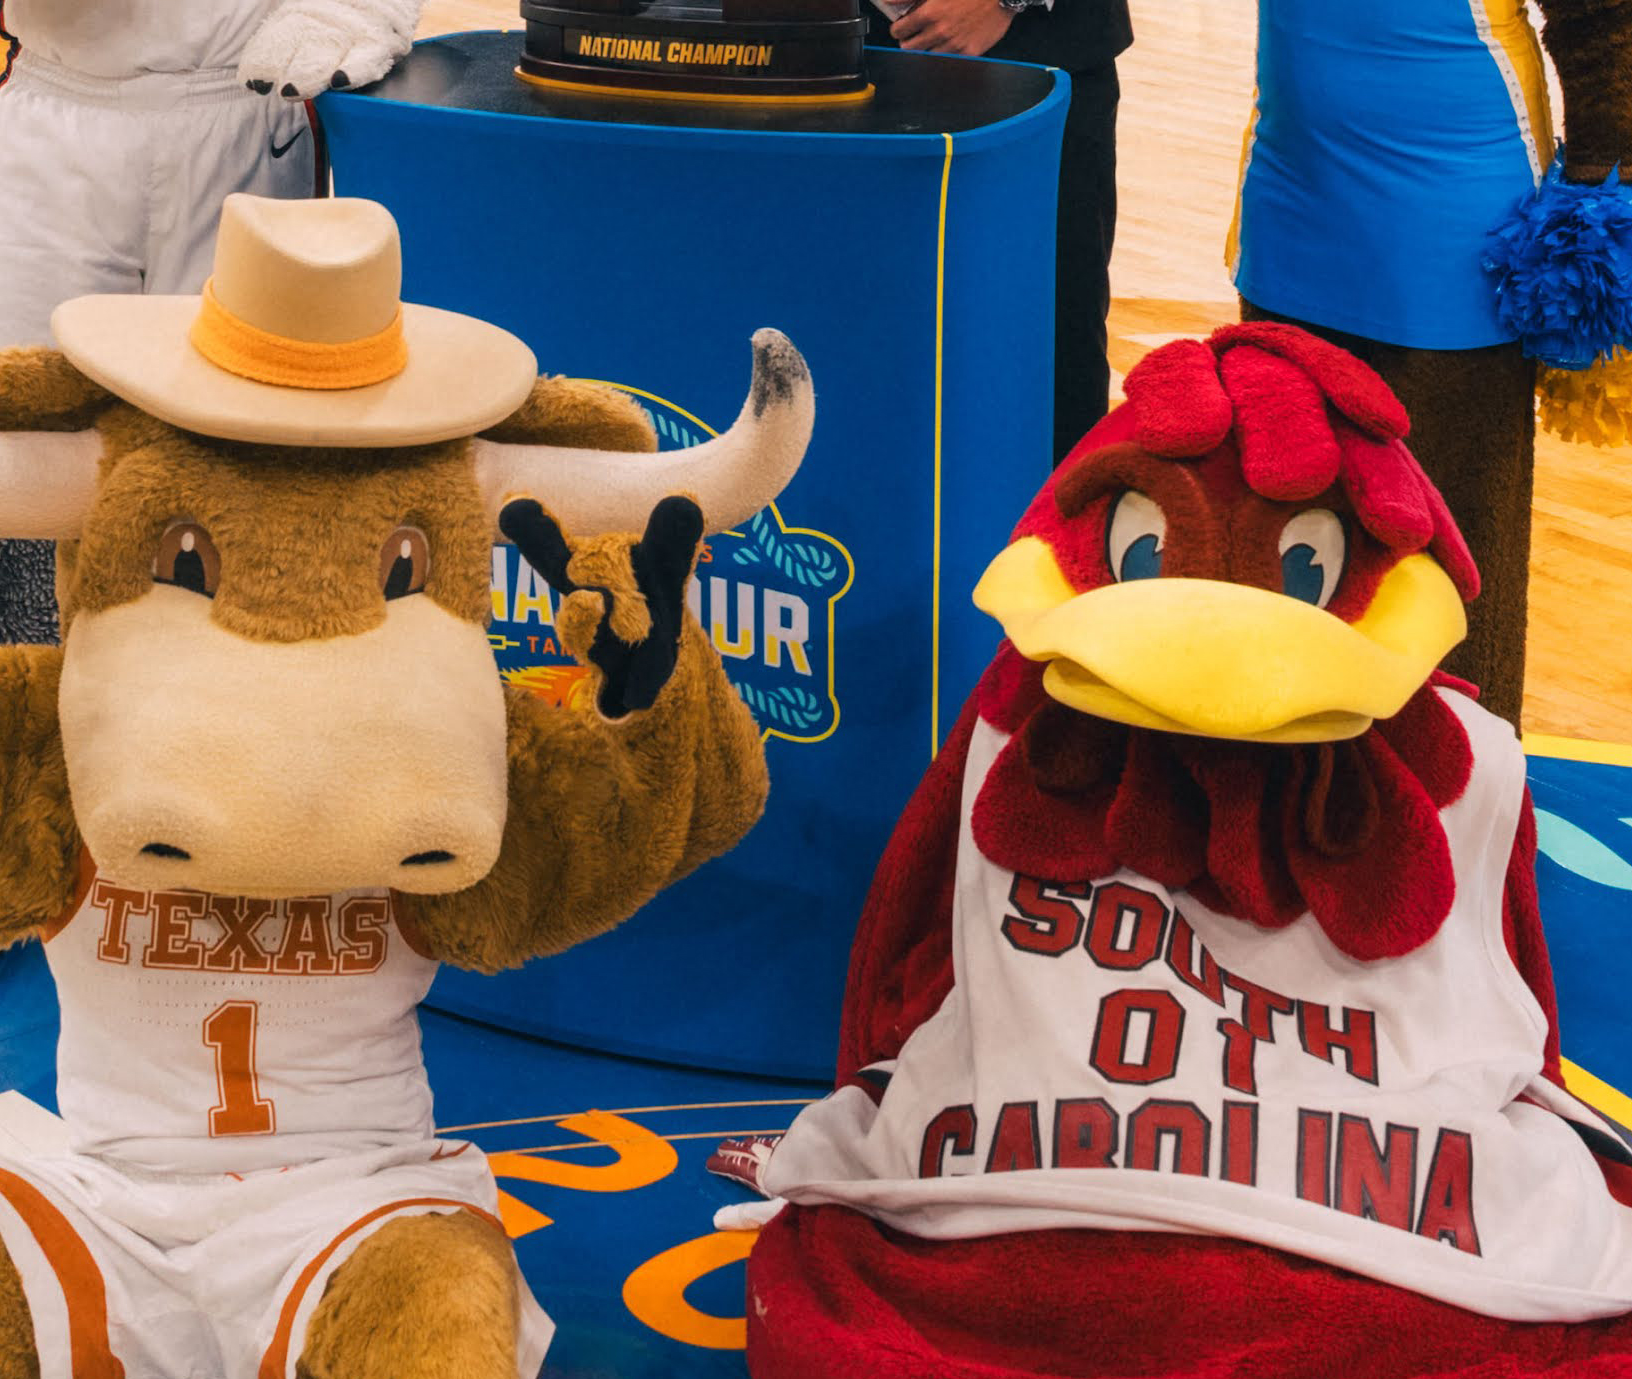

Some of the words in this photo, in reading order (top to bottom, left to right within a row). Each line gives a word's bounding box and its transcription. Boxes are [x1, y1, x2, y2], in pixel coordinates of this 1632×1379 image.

[578, 34, 662, 63] NATIONAL
[667, 39, 774, 68] CHAMPION
[90, 878, 390, 976] TEXAS
[1001, 871, 1380, 1088] SOUTH
[202, 999, 276, 1139] 1
